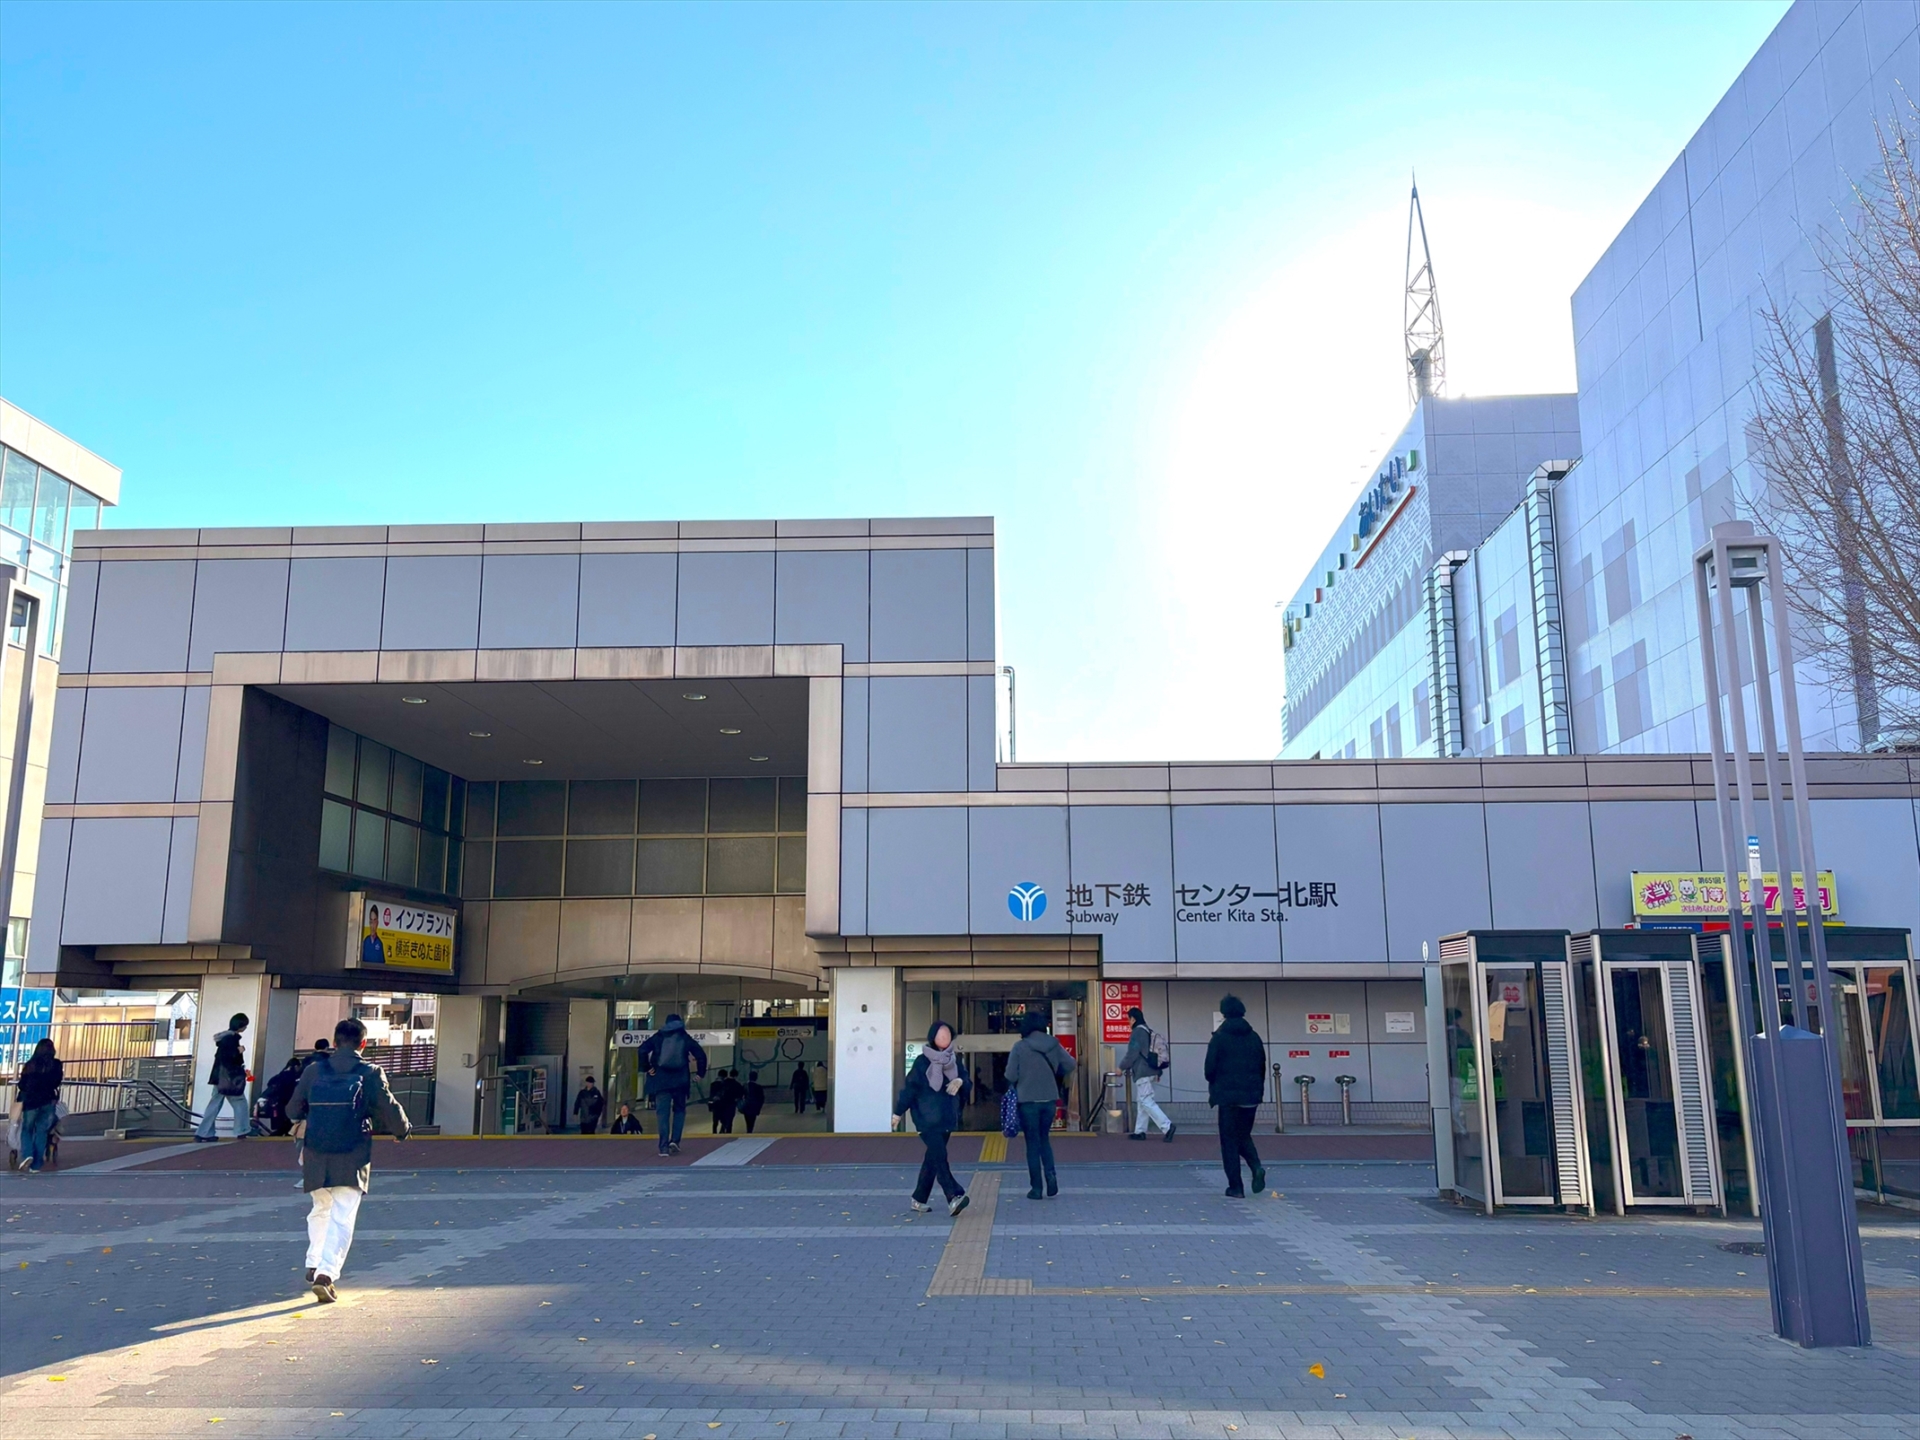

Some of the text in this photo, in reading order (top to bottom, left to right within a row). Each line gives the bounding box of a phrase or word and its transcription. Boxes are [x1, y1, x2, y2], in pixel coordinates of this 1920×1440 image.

[1066, 882, 1339, 908] 地下鉄 センター北駅
[1640, 880, 1674, 902] 大当り
[1700, 885, 1724, 904] 1等
[396, 909, 452, 936] インプラント
[1065, 909, 1119, 926] Subway
[1176, 908, 1289, 923] Center Kita Sta.
[396, 939, 450, 962] 横浜きぬた歯科
